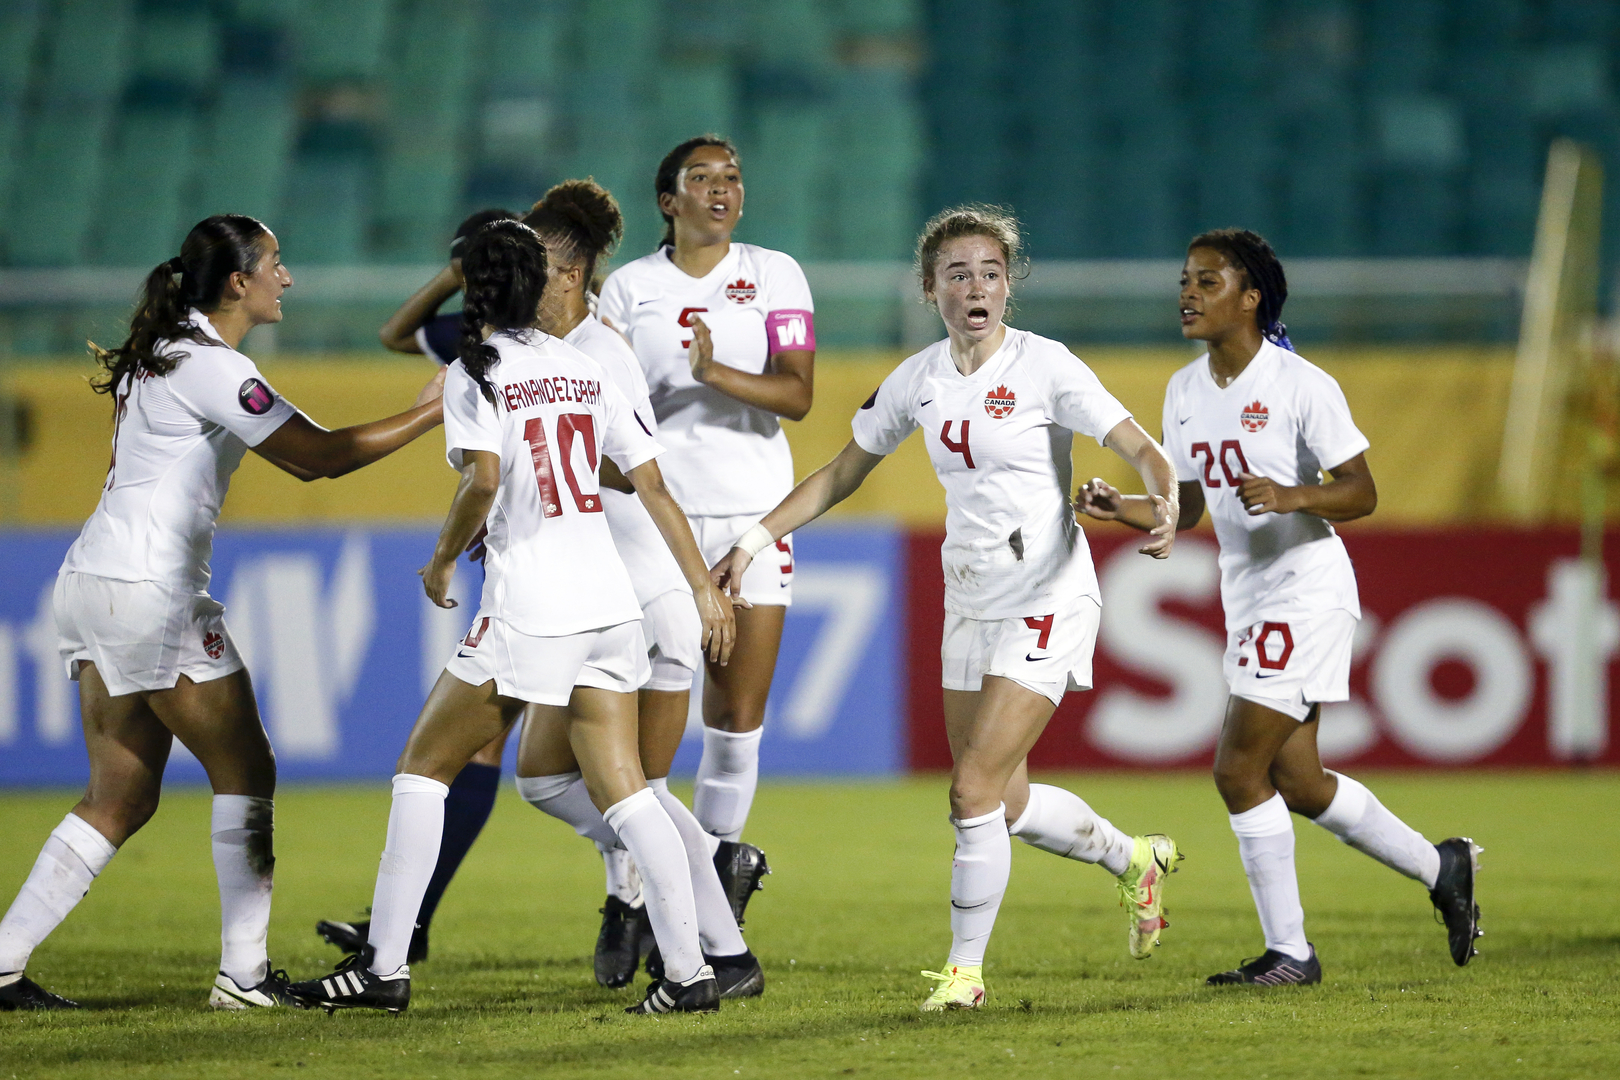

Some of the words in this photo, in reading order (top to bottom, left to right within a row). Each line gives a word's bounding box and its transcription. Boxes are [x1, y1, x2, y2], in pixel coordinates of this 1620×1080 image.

[984, 398, 1016, 406] CANADA
[523, 413, 604, 519] 10
[940, 420, 976, 469] 4
[1191, 440, 1250, 488] 20
